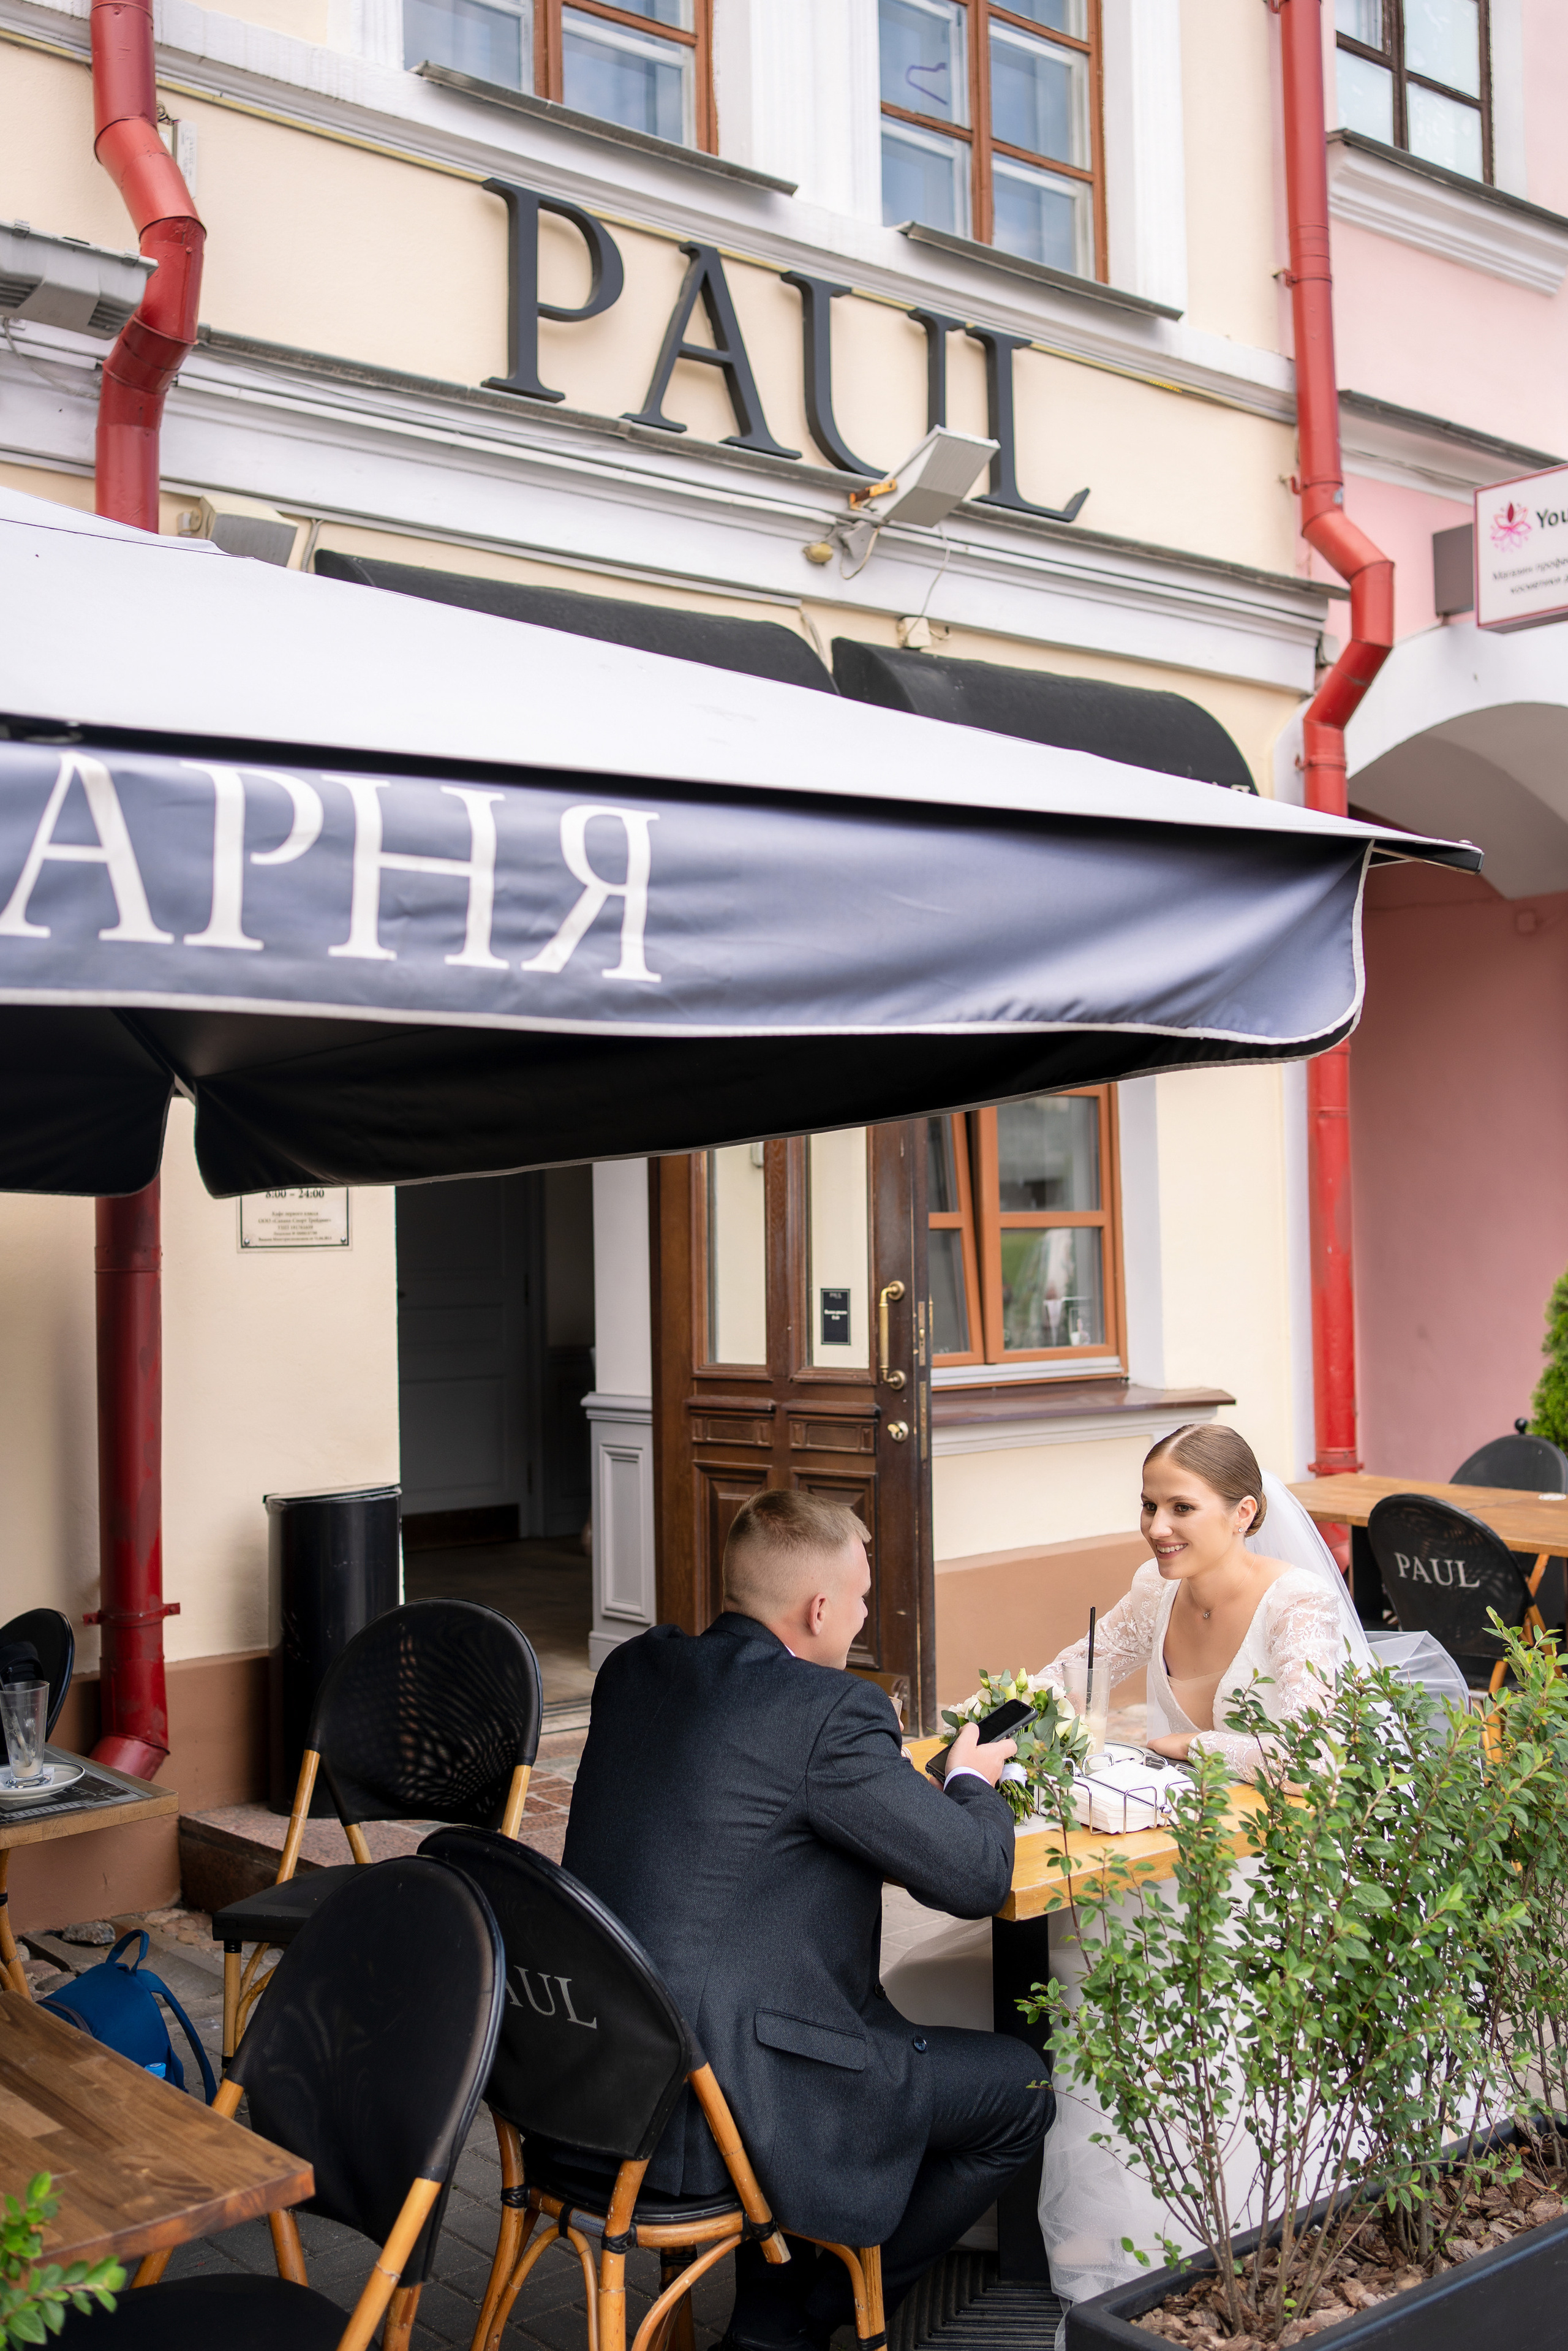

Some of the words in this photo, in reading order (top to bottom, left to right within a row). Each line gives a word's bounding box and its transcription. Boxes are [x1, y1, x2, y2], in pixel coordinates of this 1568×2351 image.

[481, 177, 1090, 521] PAUL
[0, 751, 662, 982] АРНЯ
[266, 1190, 287, 1198] 8:00
[298, 1188, 325, 1198] 24:00
[1393, 1552, 1480, 1588] PAUL
